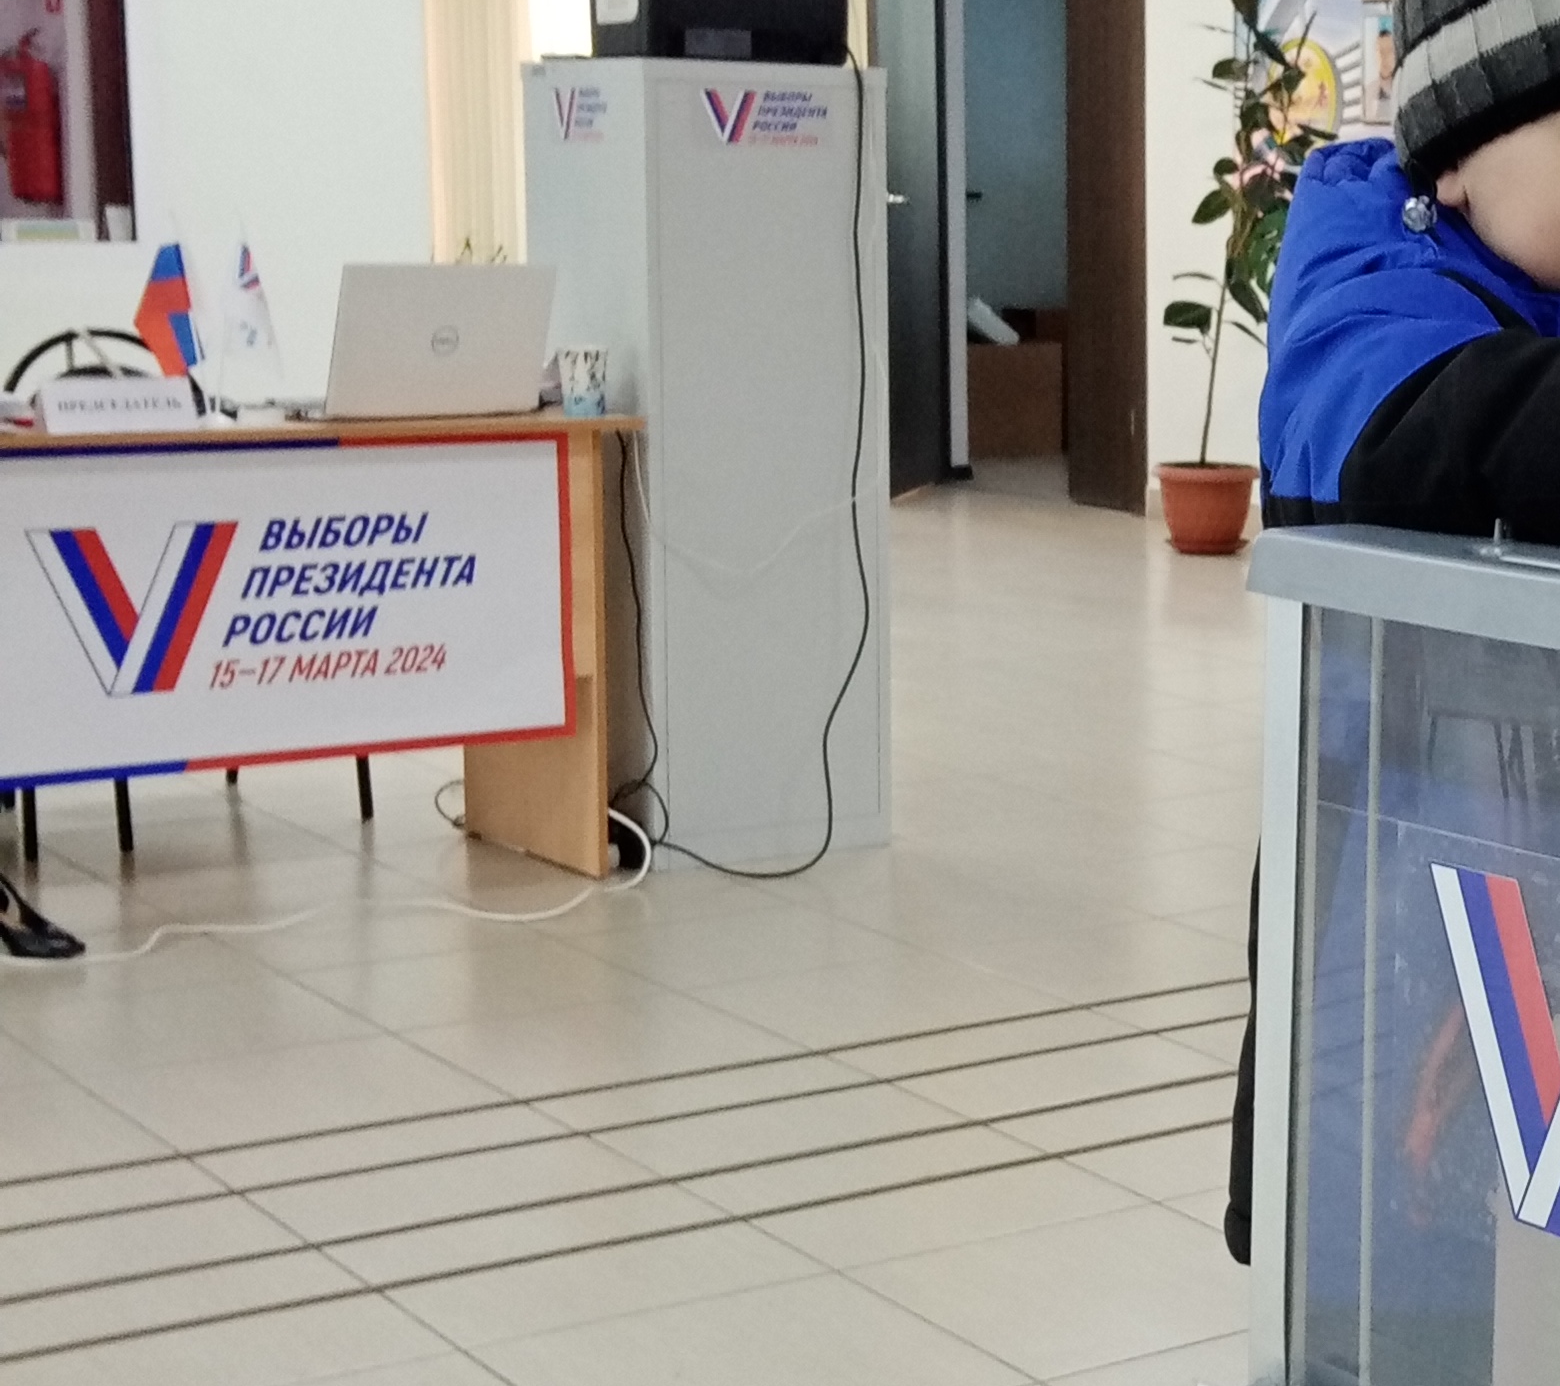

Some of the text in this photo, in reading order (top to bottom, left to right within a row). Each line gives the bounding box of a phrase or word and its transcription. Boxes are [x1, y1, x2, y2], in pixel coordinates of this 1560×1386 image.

[259, 511, 429, 551] ВЫБОРЫ
[241, 554, 476, 599] ПРЕЗИДЕНТА
[222, 605, 378, 647] РОССИИ
[288, 648, 379, 683] МАРТА
[384, 642, 447, 676] 2024
